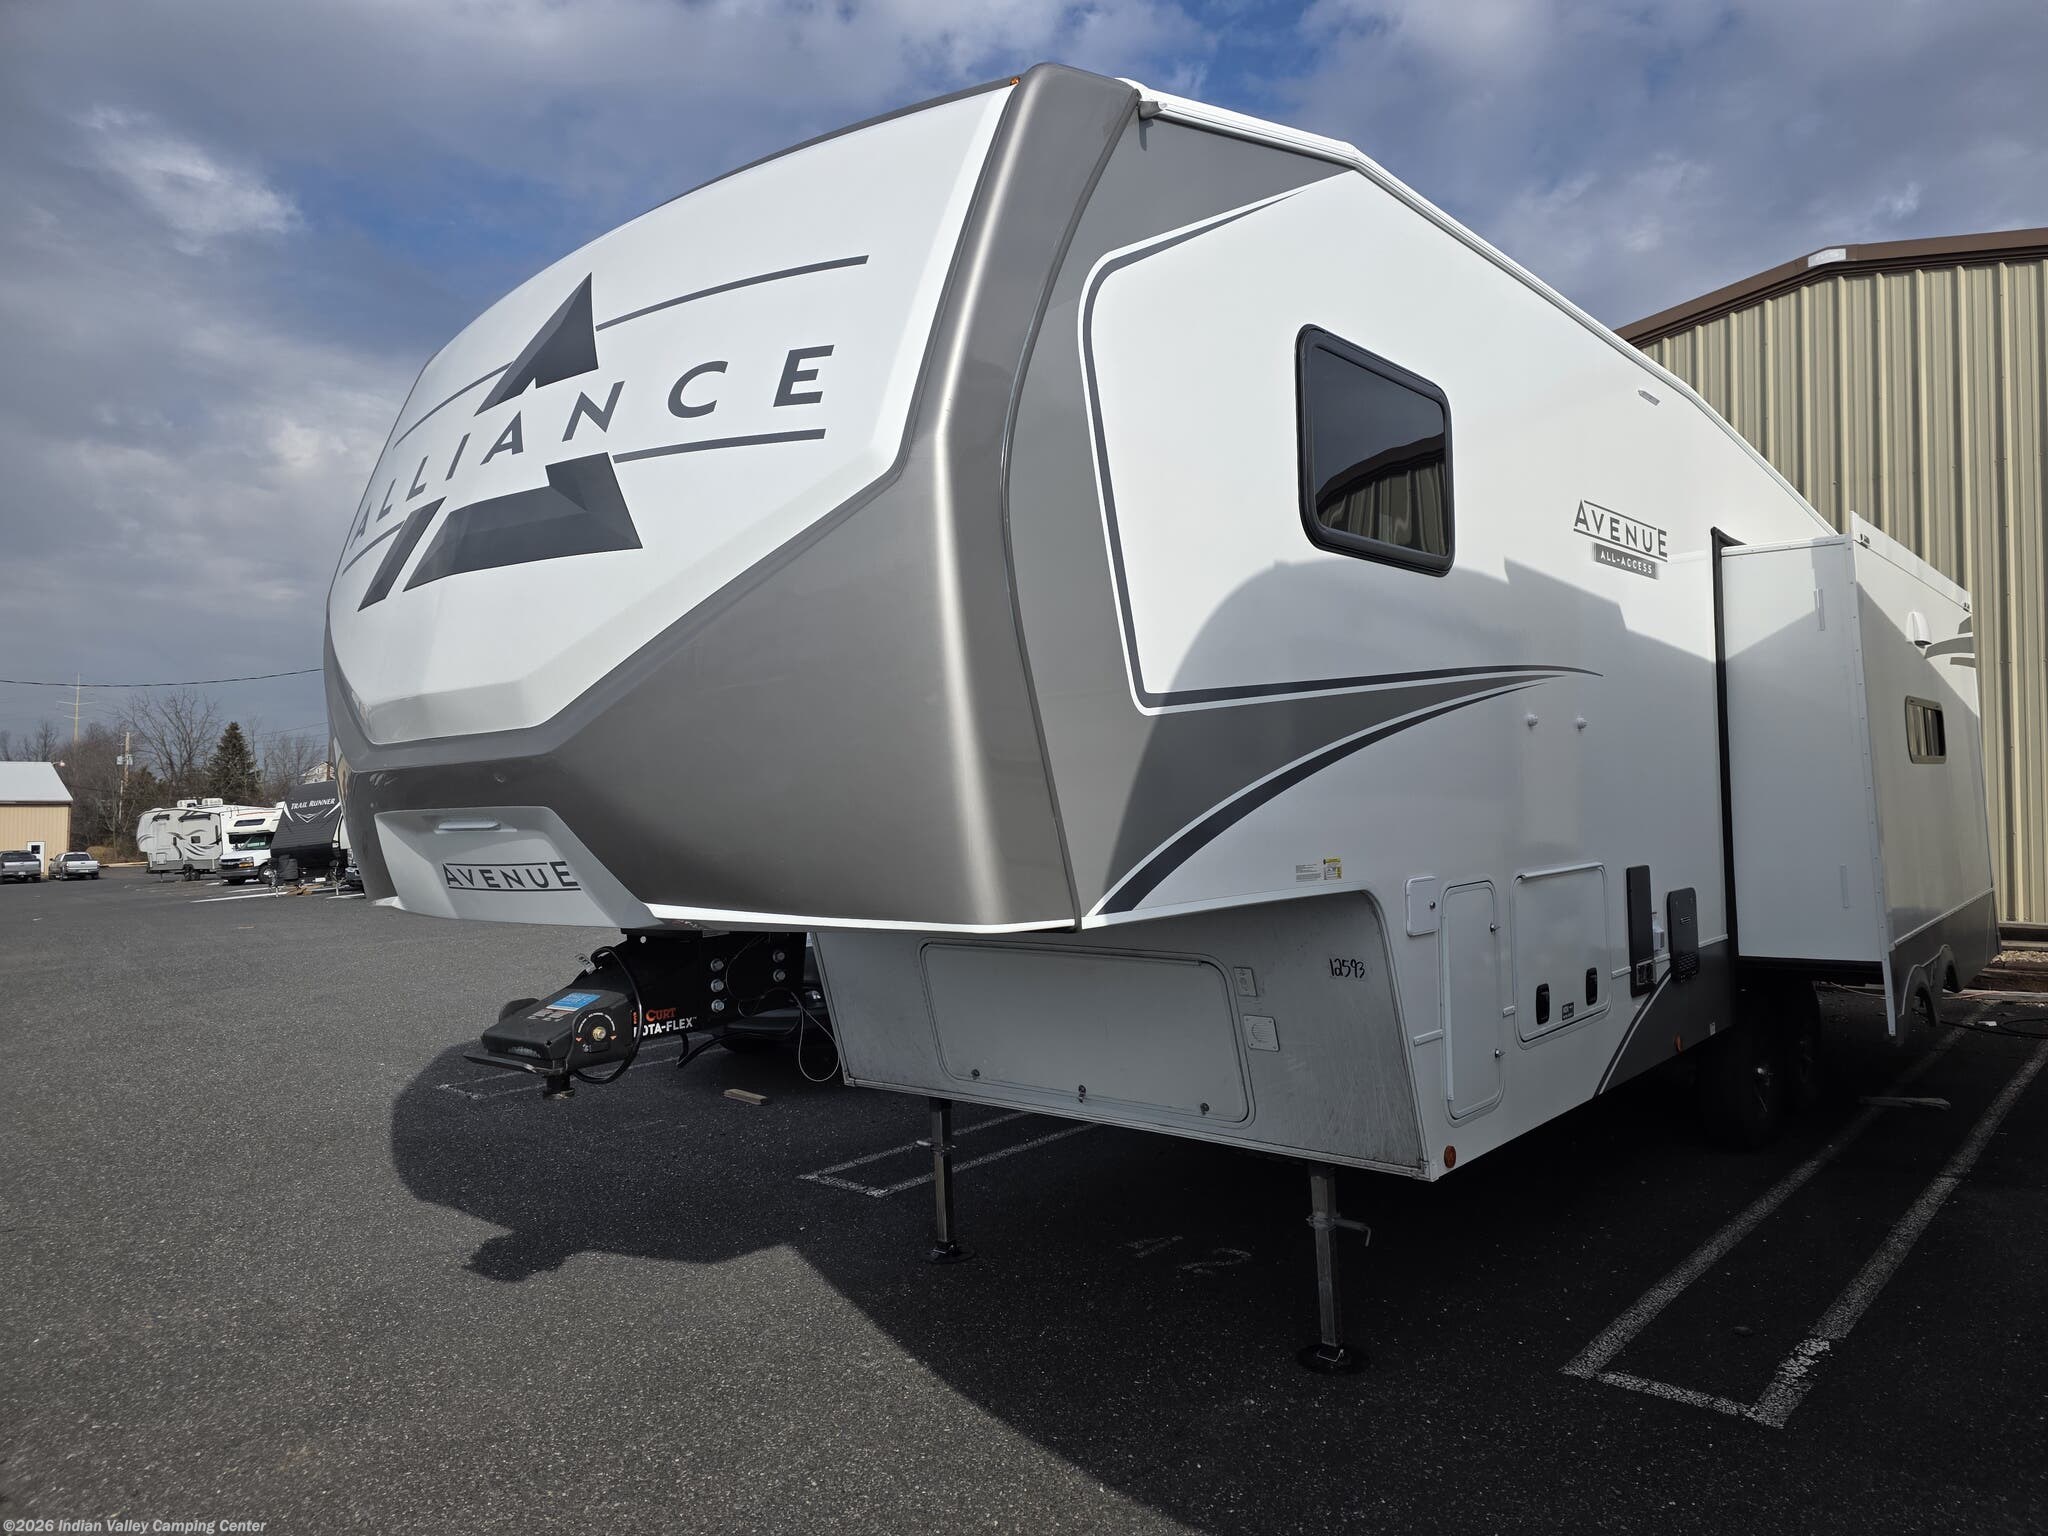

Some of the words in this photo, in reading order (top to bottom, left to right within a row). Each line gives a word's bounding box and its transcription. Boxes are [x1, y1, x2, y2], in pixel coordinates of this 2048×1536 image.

[349, 344, 835, 550] ALLIANCE
[1574, 499, 1668, 558] AVENUE
[1600, 550, 1653, 575] ALL-ACCESS
[291, 801, 308, 810] TRAIL
[309, 798, 336, 807] RUNNER
[443, 861, 579, 889] AVENUE
[1329, 957, 1366, 979] 12593
[645, 1006, 677, 1022] CURT
